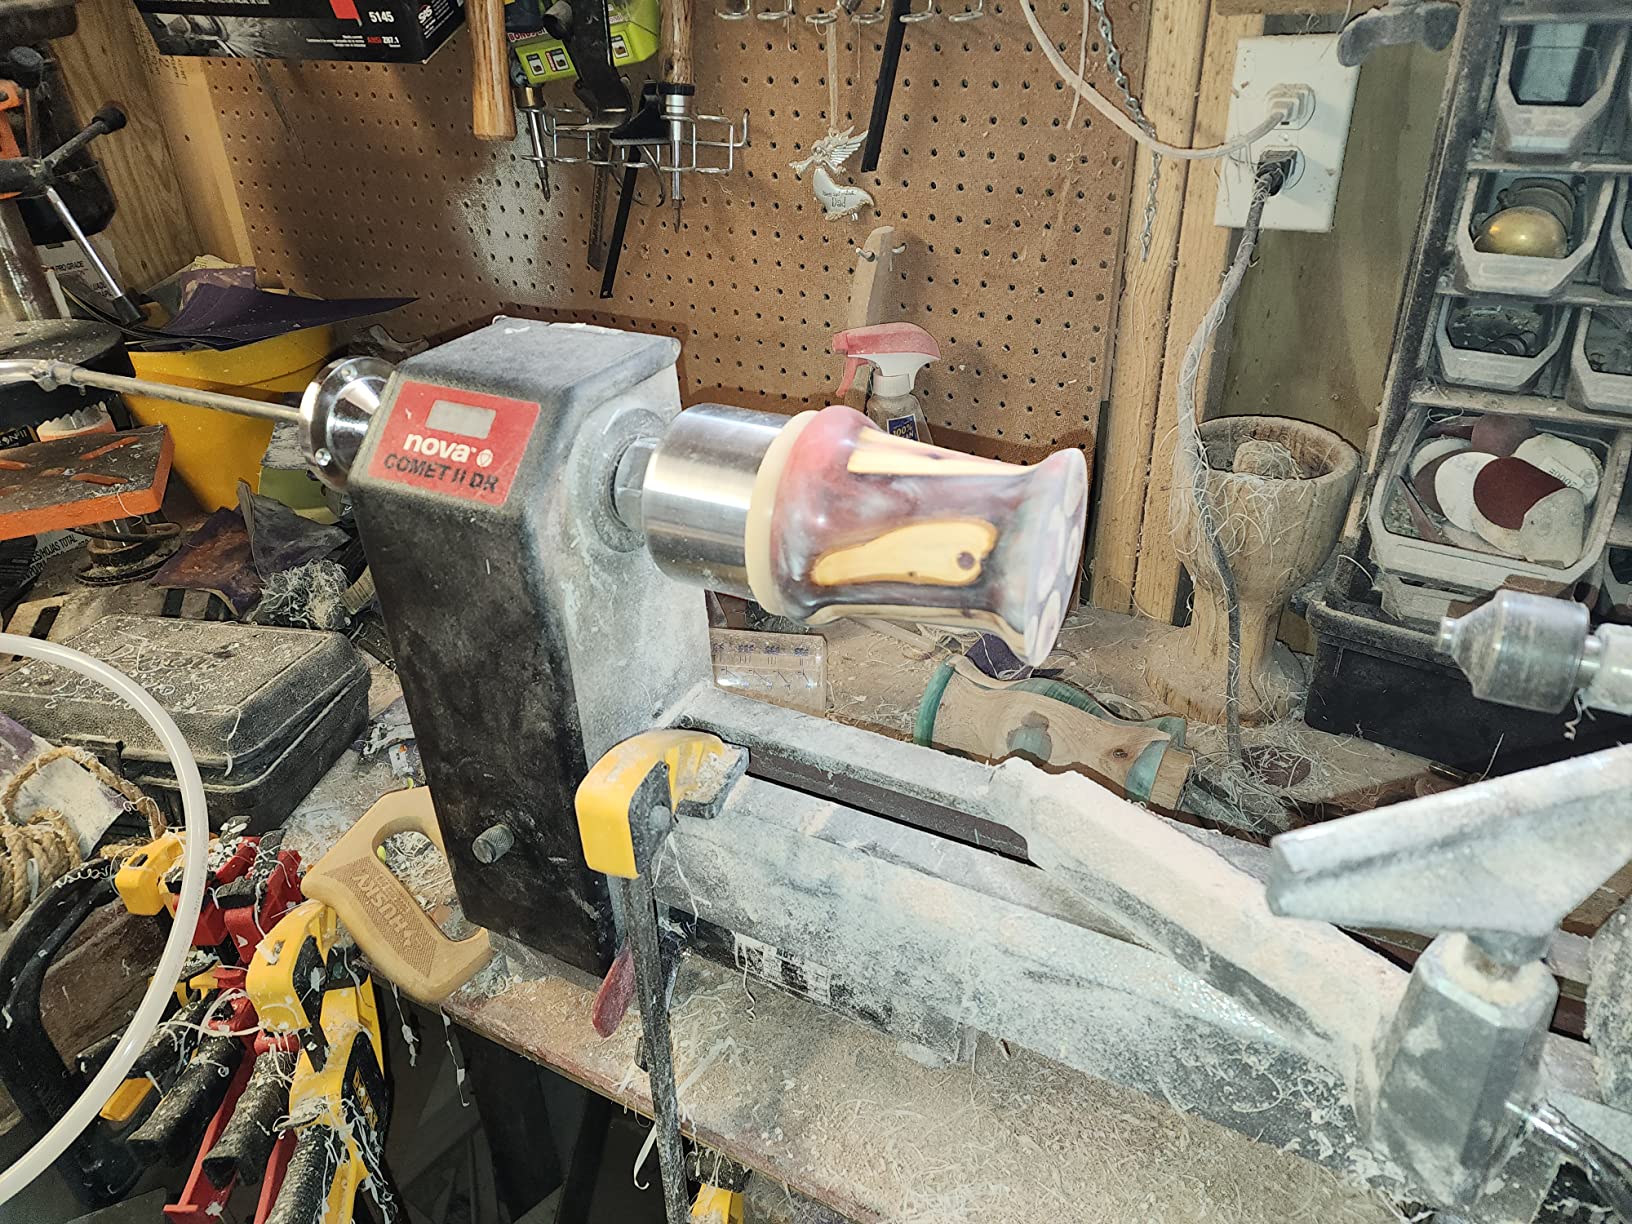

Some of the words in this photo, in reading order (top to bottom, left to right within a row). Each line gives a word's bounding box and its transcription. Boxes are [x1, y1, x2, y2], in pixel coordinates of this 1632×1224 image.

[368, 11, 395, 23] 5145
[403, 433, 468, 463] nova
[384, 453, 451, 481] COMET
[469, 472, 499, 493] DR
[59, 534, 77, 548] TOTAL
[352, 873, 409, 933] HUSKY
